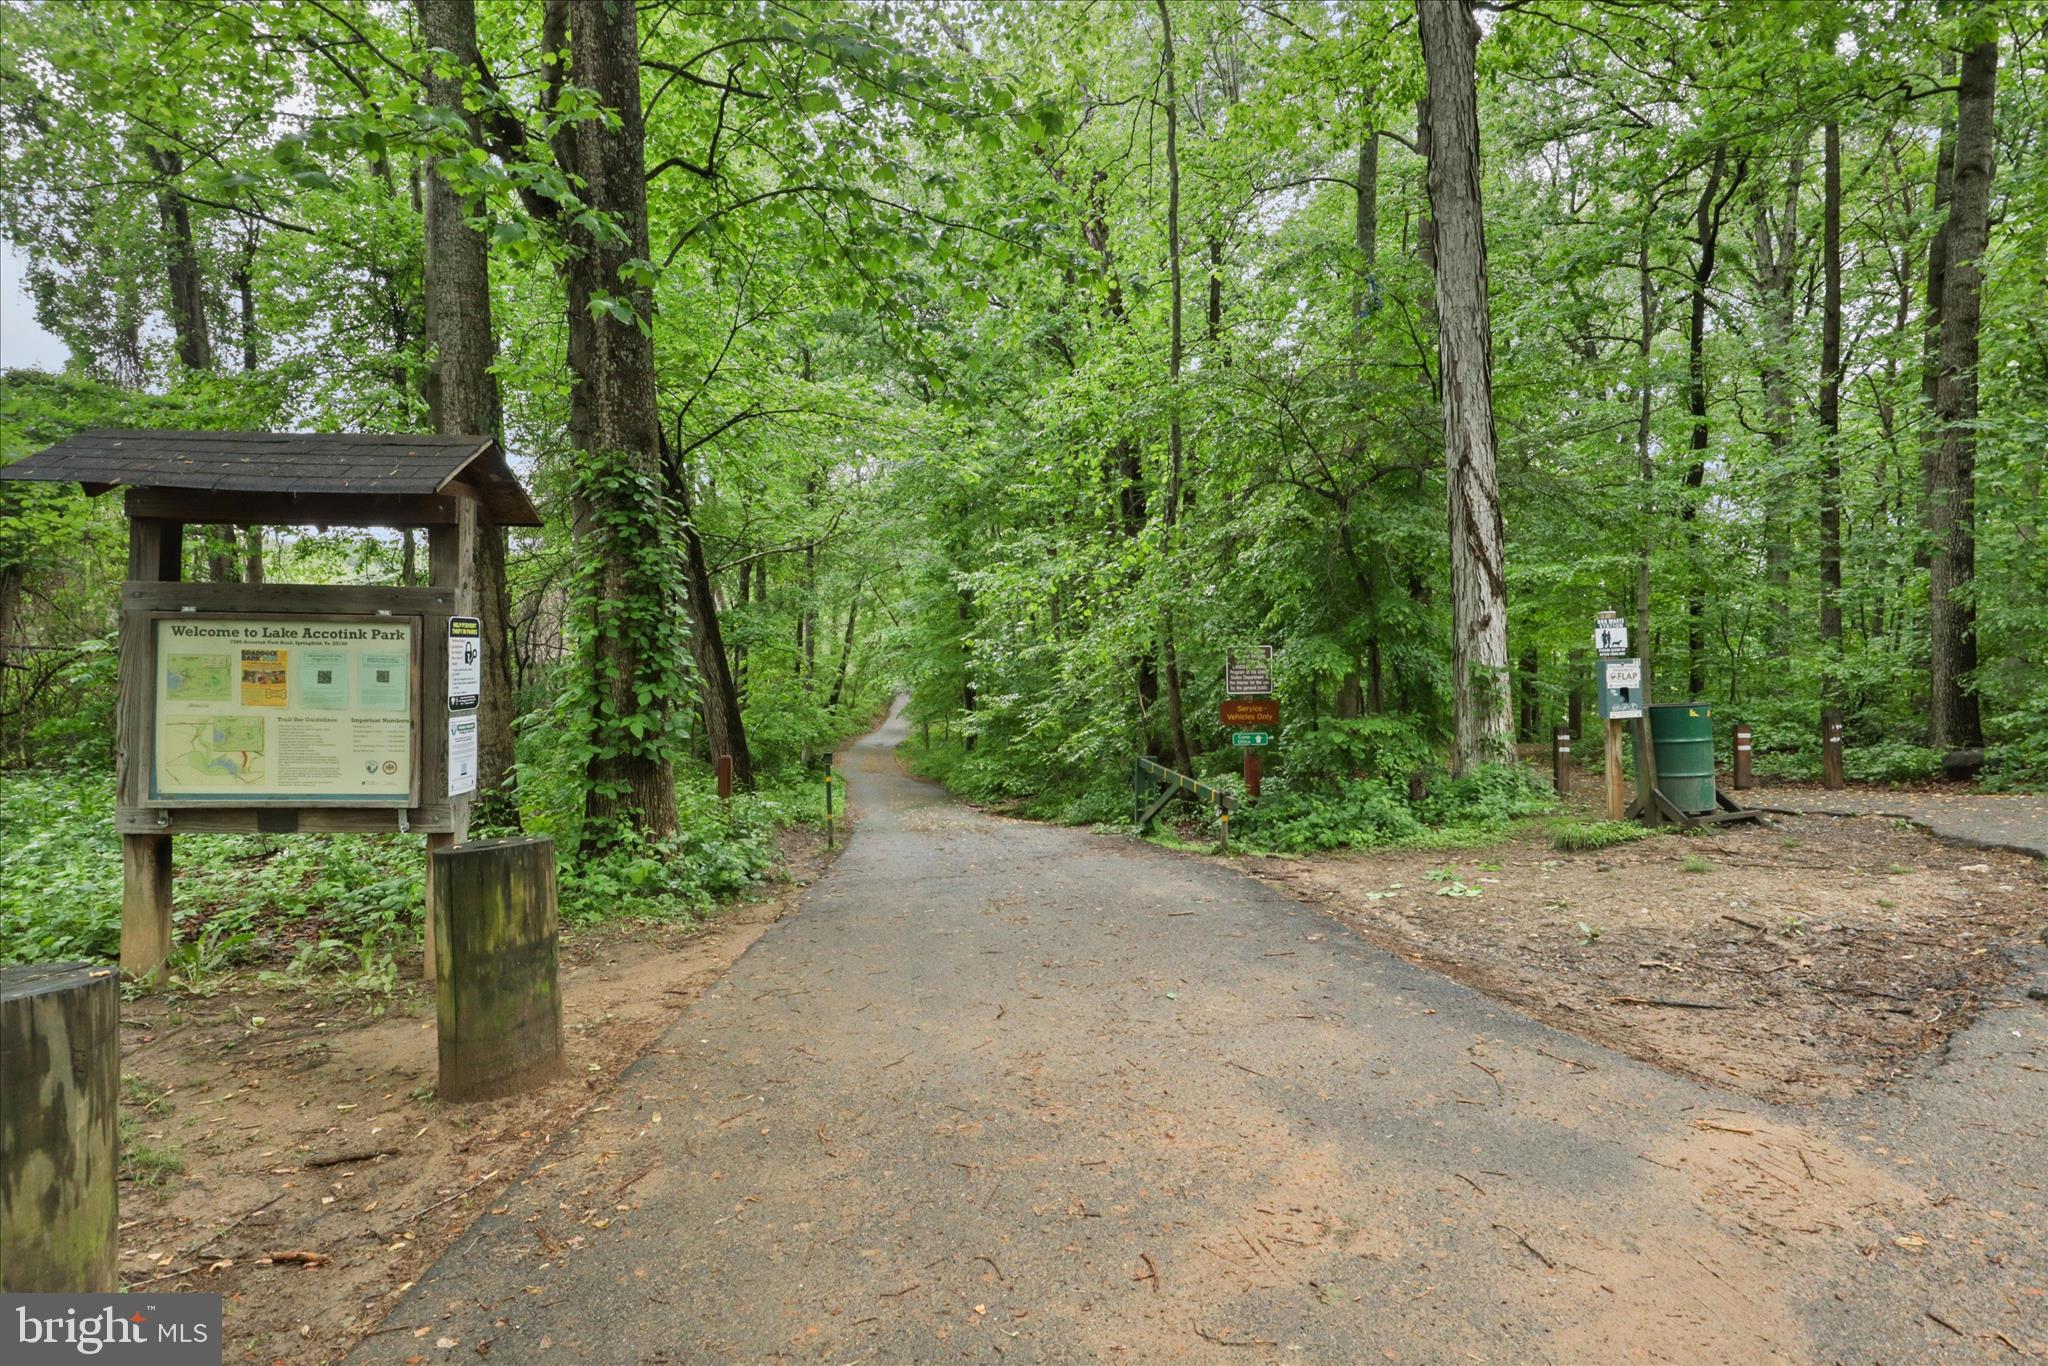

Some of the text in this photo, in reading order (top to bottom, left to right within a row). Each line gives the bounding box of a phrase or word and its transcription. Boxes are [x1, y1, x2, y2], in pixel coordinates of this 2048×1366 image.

[171, 625, 405, 640] Welcome to Lake Accotink Park
[1617, 672, 1638, 680] FLAP
[1237, 705, 1263, 713] Service
[1257, 713, 1273, 721] Only
